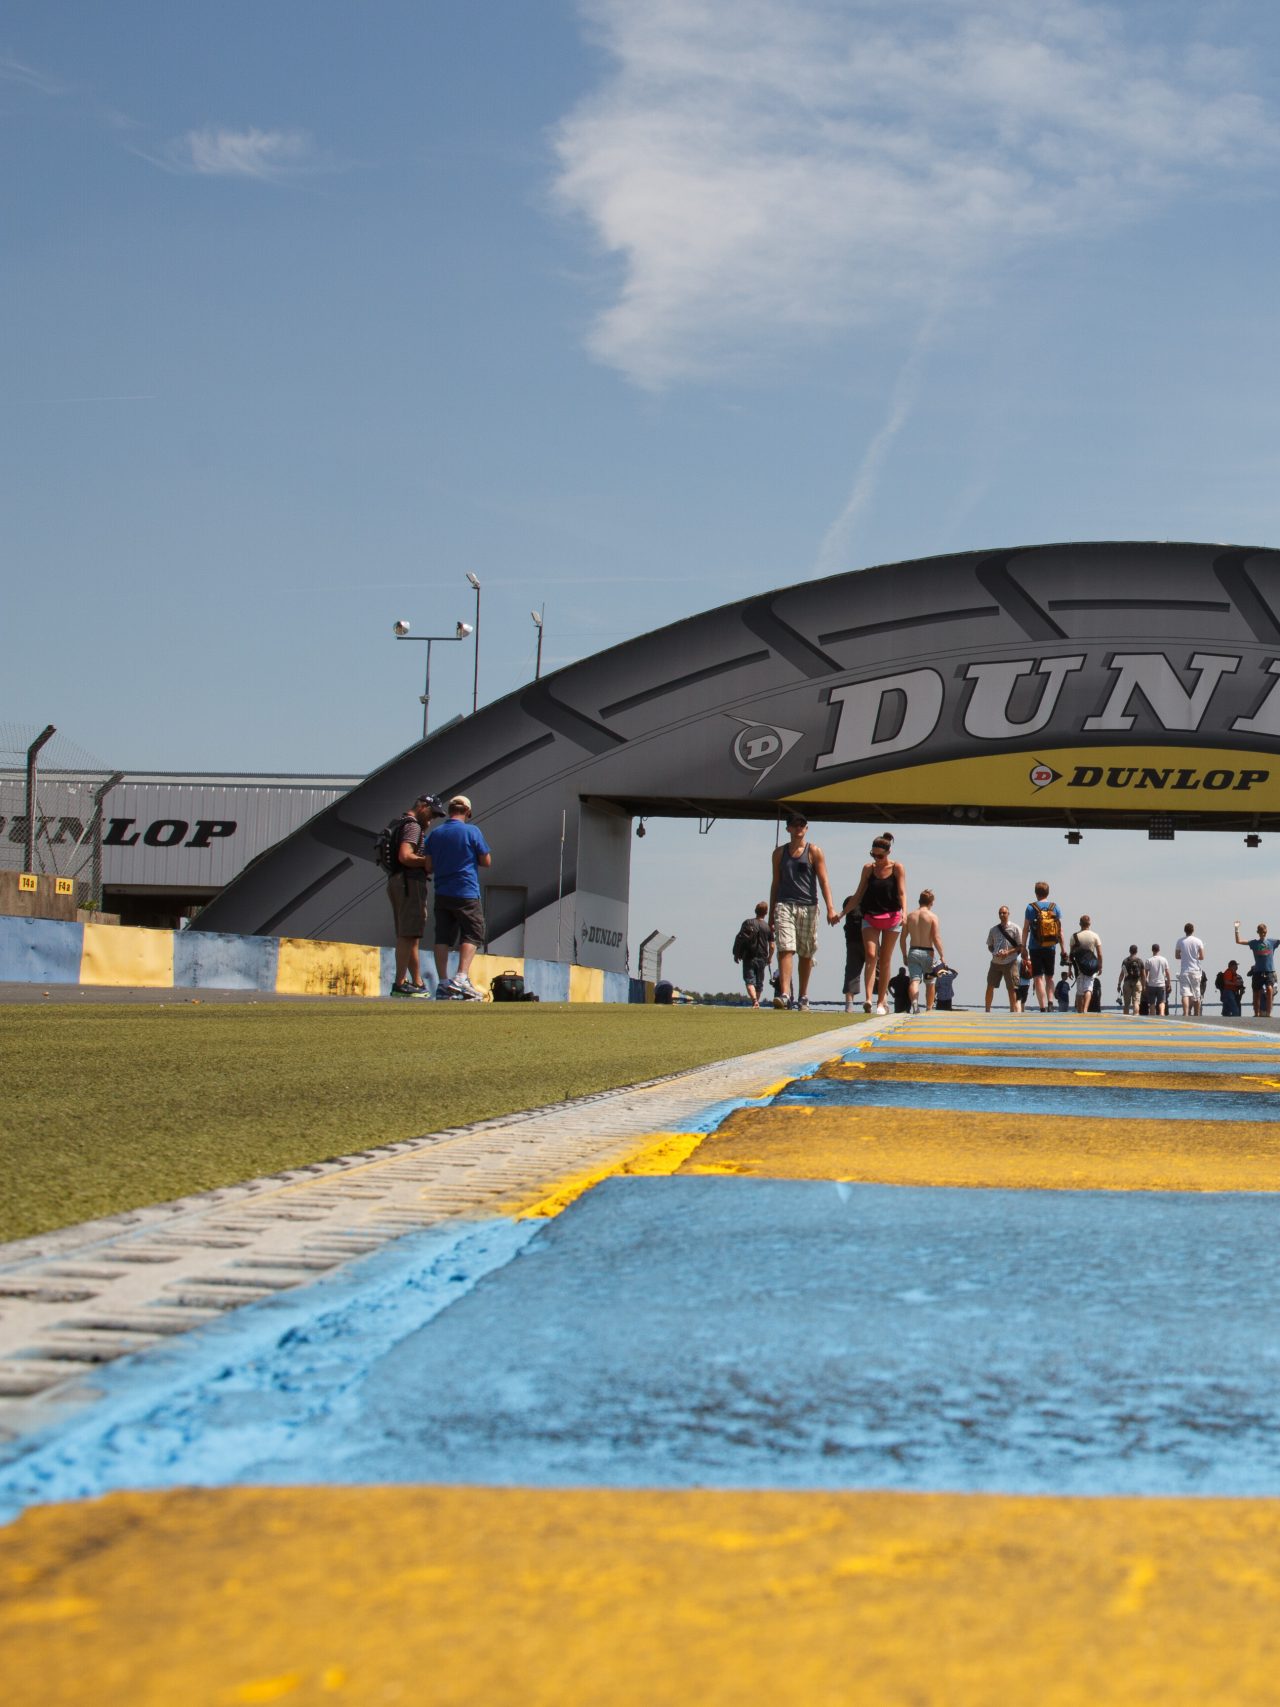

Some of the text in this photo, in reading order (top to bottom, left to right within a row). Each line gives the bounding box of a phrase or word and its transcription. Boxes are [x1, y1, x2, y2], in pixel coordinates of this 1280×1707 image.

[747, 736, 779, 760] D
[1033, 766, 1270, 791] D DUNLOP
[0, 816, 237, 848] UNLOP
[588, 926, 623, 948] DUNLOP
